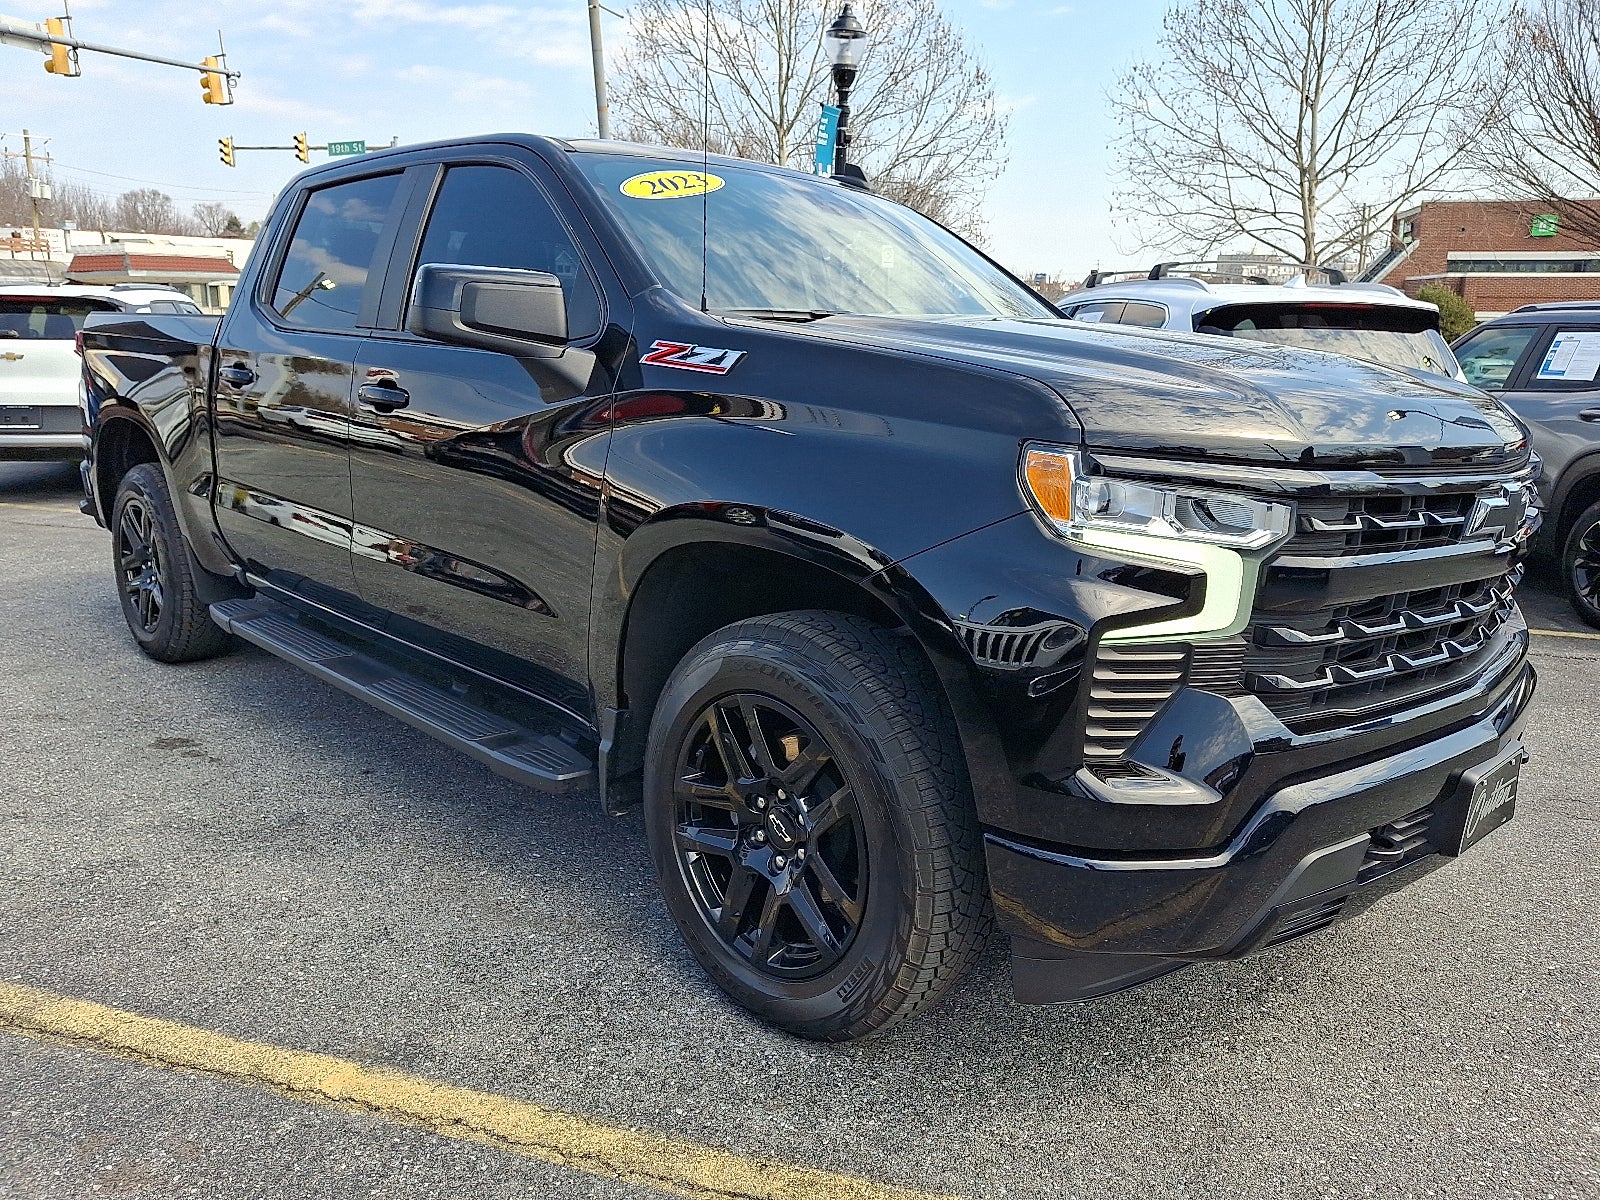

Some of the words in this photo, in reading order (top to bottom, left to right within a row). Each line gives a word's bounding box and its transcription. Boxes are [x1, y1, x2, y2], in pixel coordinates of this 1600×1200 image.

[331, 143, 350, 154] 19th
[352, 142, 362, 152] St
[640, 174, 708, 194] 2023
[639, 340, 747, 375] Z71
